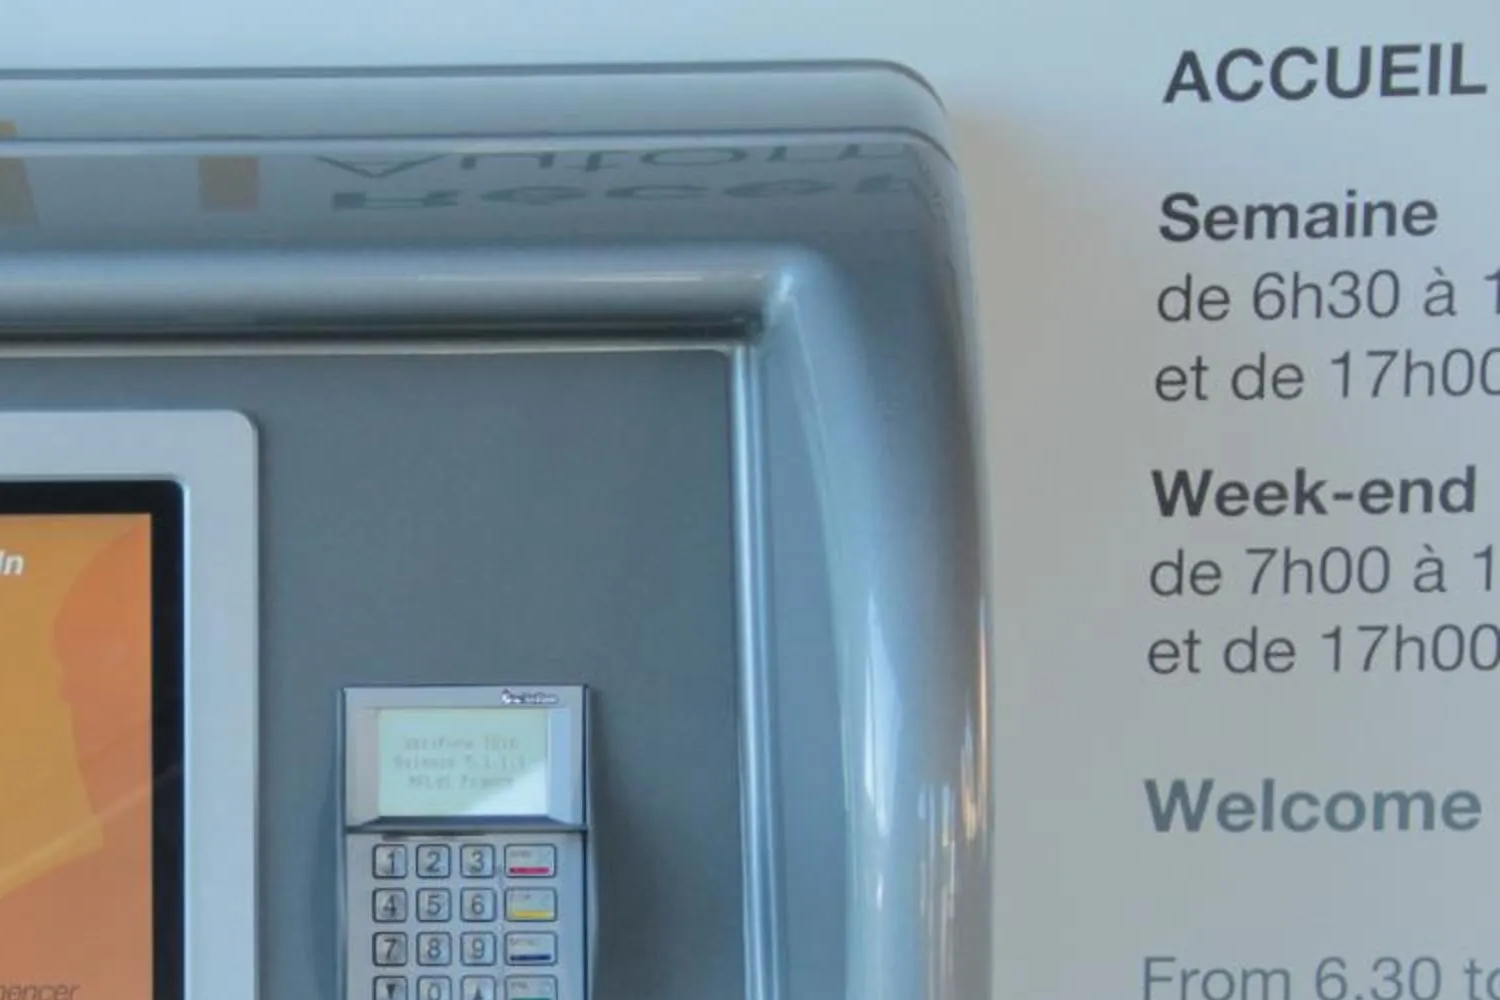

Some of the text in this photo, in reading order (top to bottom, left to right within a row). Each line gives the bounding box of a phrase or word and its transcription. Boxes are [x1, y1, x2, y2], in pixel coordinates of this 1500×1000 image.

[1162, 41, 1488, 104] ACCUEIL
[1158, 188, 1438, 244] Semaine
[1156, 272, 1231, 323] de
[1252, 269, 1401, 321] 6h30
[1422, 266, 1458, 318] à
[1155, 355, 1210, 403] et
[1230, 351, 1305, 401] de
[1150, 464, 1476, 518] Week-end
[1149, 547, 1223, 598] de
[1245, 545, 1391, 596] 7h00
[1413, 543, 1448, 594] à
[1147, 623, 1500, 675] et de 17h00
[1142, 777, 1482, 834] Welcome
[386, 852, 485, 874] 1 2 3
[383, 895, 485, 917] 4 5 6
[384, 938, 397, 961] 7
[427, 938, 442, 961] 8
[471, 938, 485, 961] 9
